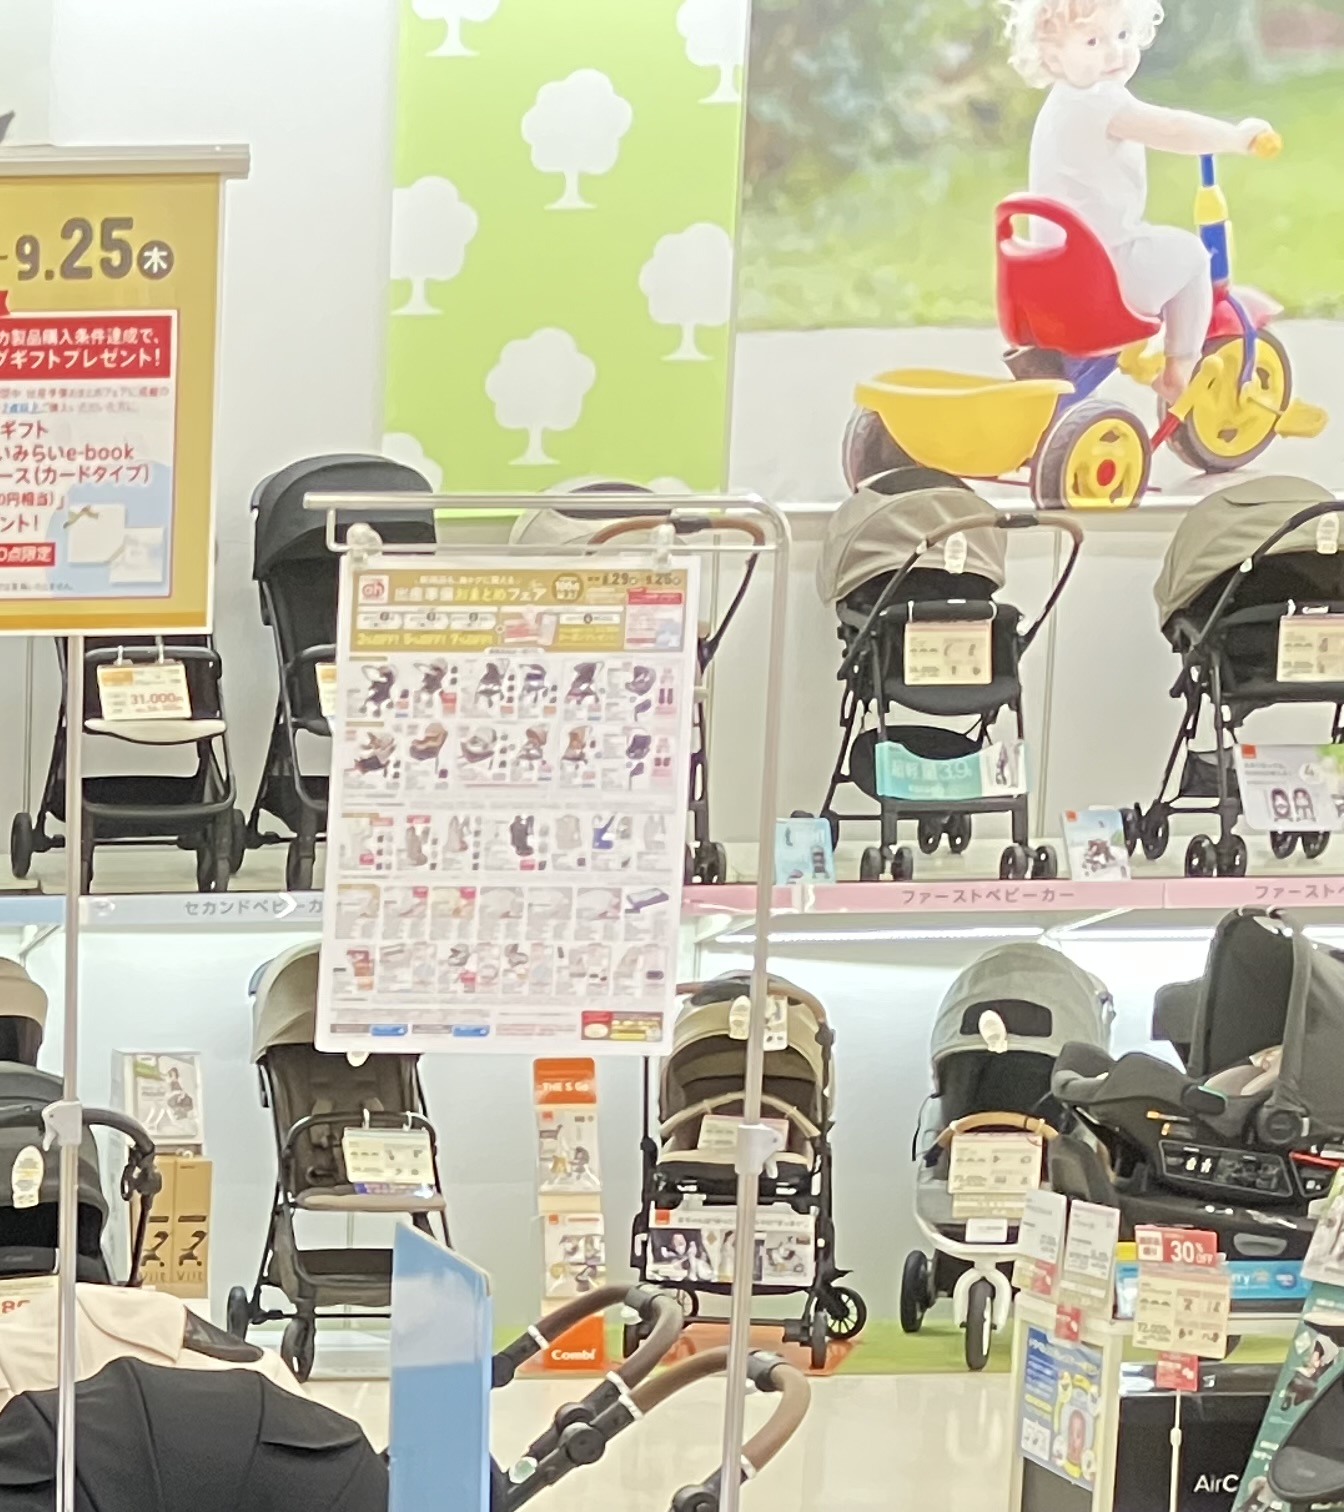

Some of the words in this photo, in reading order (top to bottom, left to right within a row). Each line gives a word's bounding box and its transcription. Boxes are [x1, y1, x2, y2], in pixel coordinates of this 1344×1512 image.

[902, 886, 1075, 904] ファーストベビーカー
[552, 1347, 596, 1361] Combi
